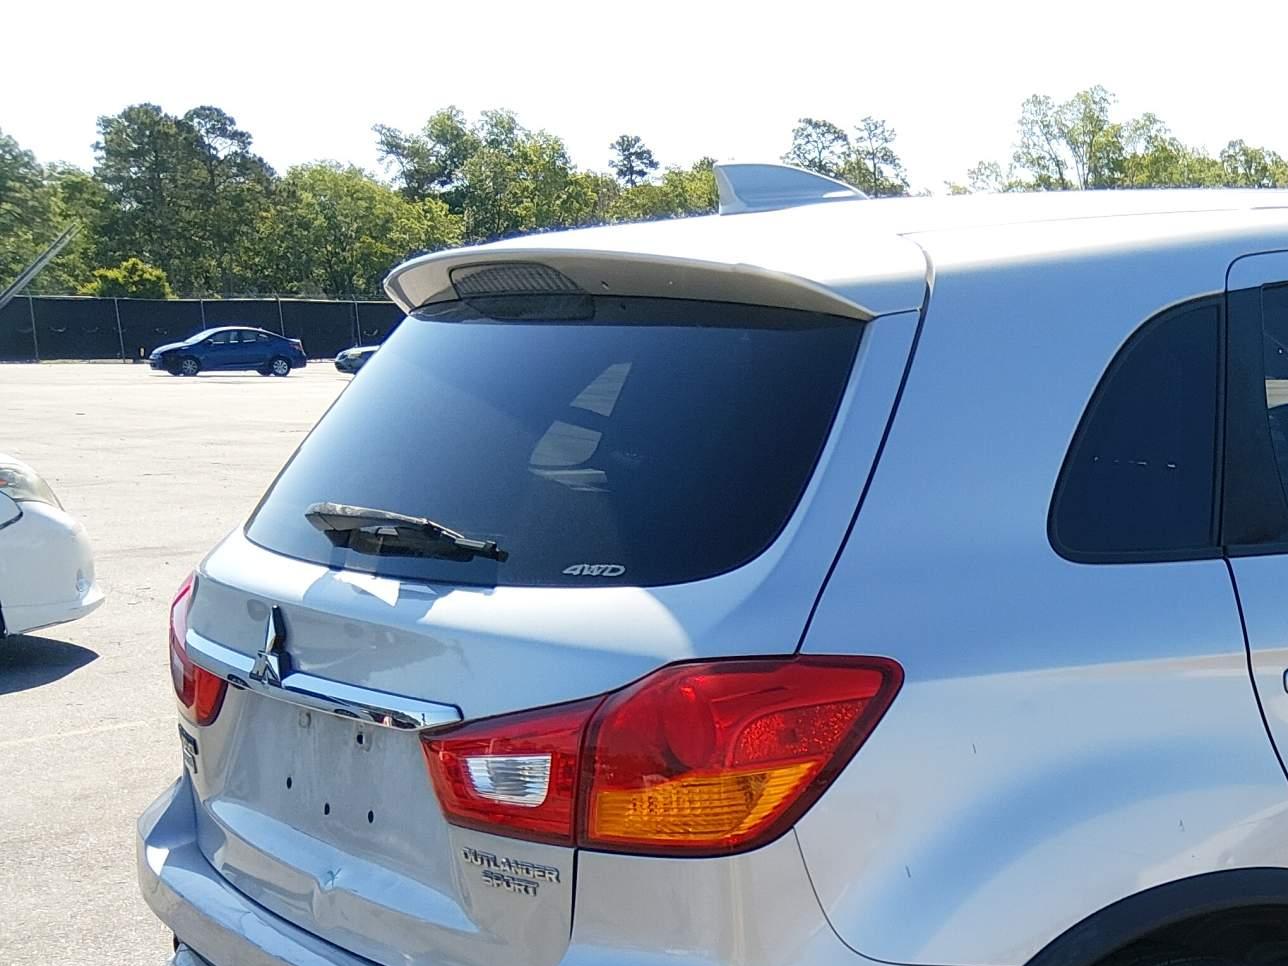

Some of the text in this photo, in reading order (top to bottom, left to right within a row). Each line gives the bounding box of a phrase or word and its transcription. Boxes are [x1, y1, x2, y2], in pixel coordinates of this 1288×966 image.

[562, 563, 626, 577] 4WD
[461, 847, 561, 884] OUTLANDER
[481, 870, 540, 897] SPORT
